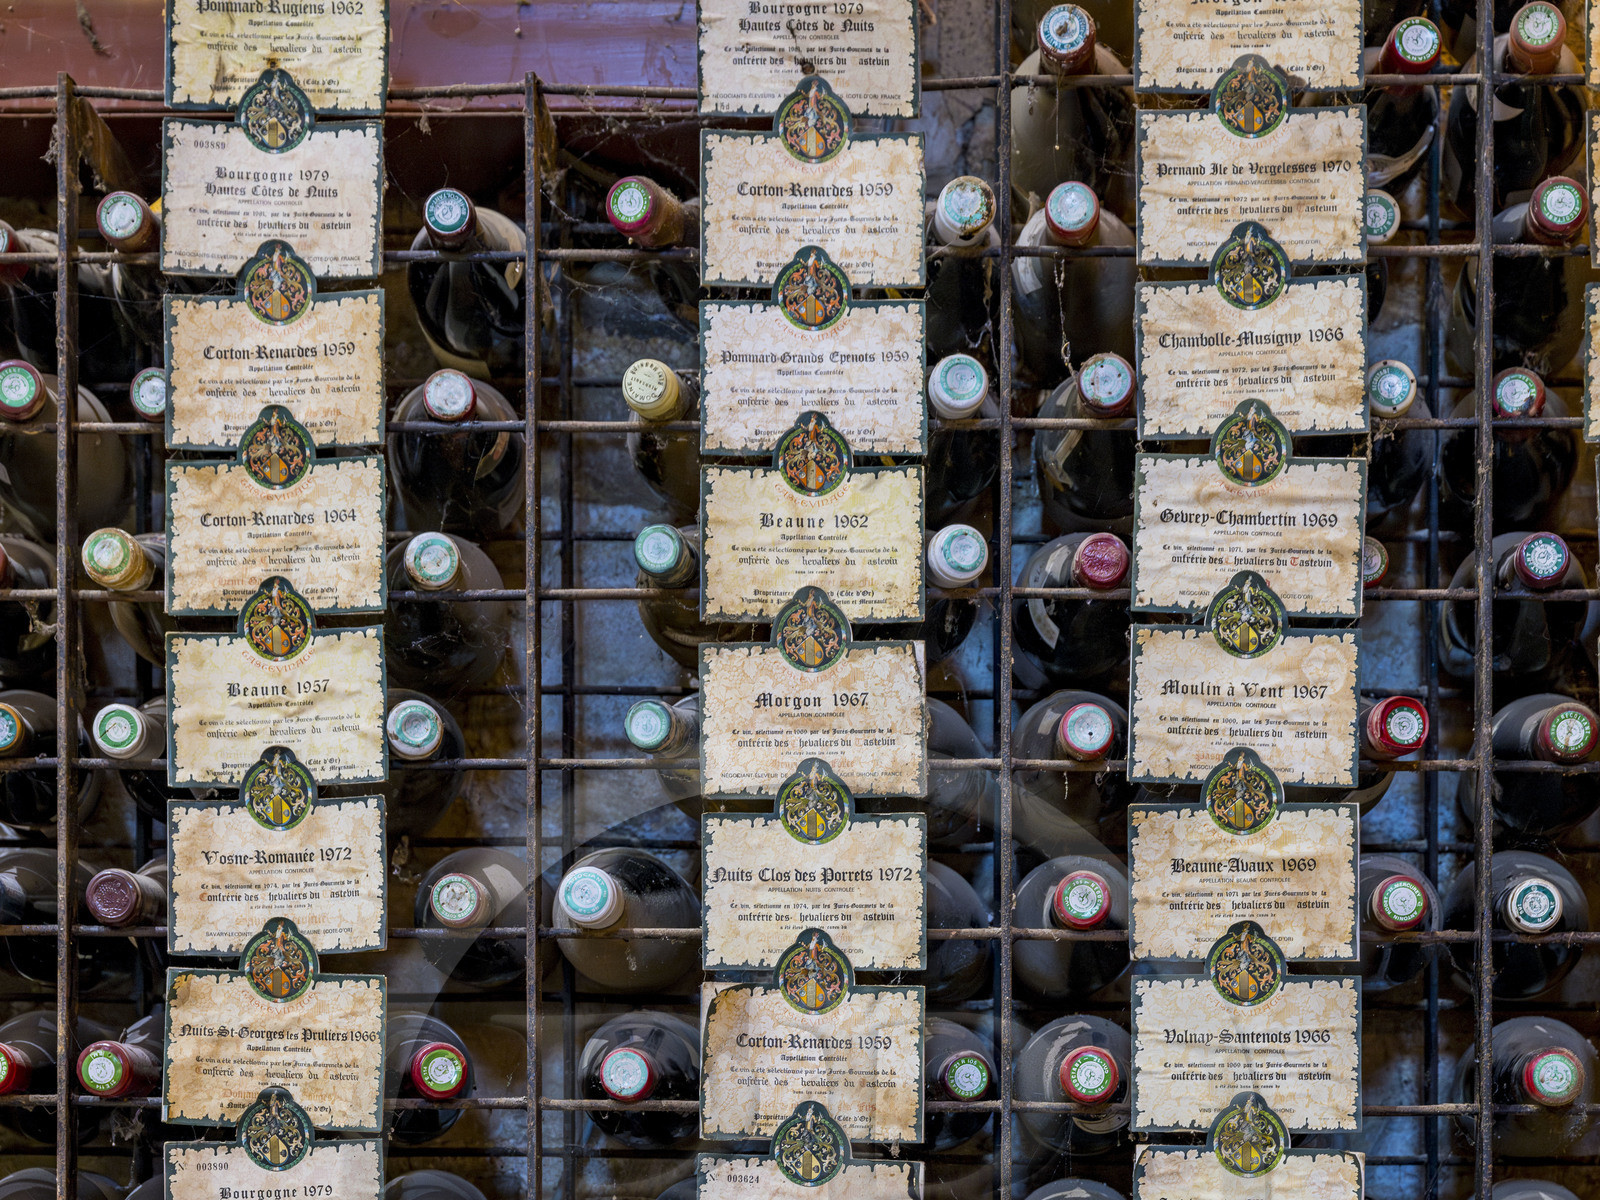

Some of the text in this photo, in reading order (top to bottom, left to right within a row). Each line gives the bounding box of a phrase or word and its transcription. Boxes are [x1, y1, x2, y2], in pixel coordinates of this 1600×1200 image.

[834, 3, 863, 15] 1979
[1322, 160, 1351, 172] 1970
[860, 183, 893, 196] 1959
[1159, 327, 1343, 349] Chambolle-Musigny 1966
[204, 342, 355, 360] Corton-Renardes 1959
[882, 351, 909, 361] 1959
[201, 509, 356, 527] Corton-Renardes 1964
[760, 513, 868, 529] Beaune 1962
[1160, 509, 1337, 527] Gevrey-Chambertin 1969
[227, 679, 329, 697] Beaune 1957
[1160, 680, 1328, 699] Moulin à Vent 1967
[754, 693, 868, 710] Morgon 1967
[201, 847, 351, 864] Vosne-Romanée 1972
[1282, 858, 1316, 871] 1969
[710, 867, 912, 884] Nuits Clos des Porrets 1972
[301, 1028, 348, 1042] Pruliers
[351, 1031, 376, 1042] 1966
[736, 1033, 891, 1050] Corton-Renardes 1959
[1163, 1029, 1330, 1046] Volnay-Santenots 1966
[220, 1185, 332, 1200] Bourgogne 1979
